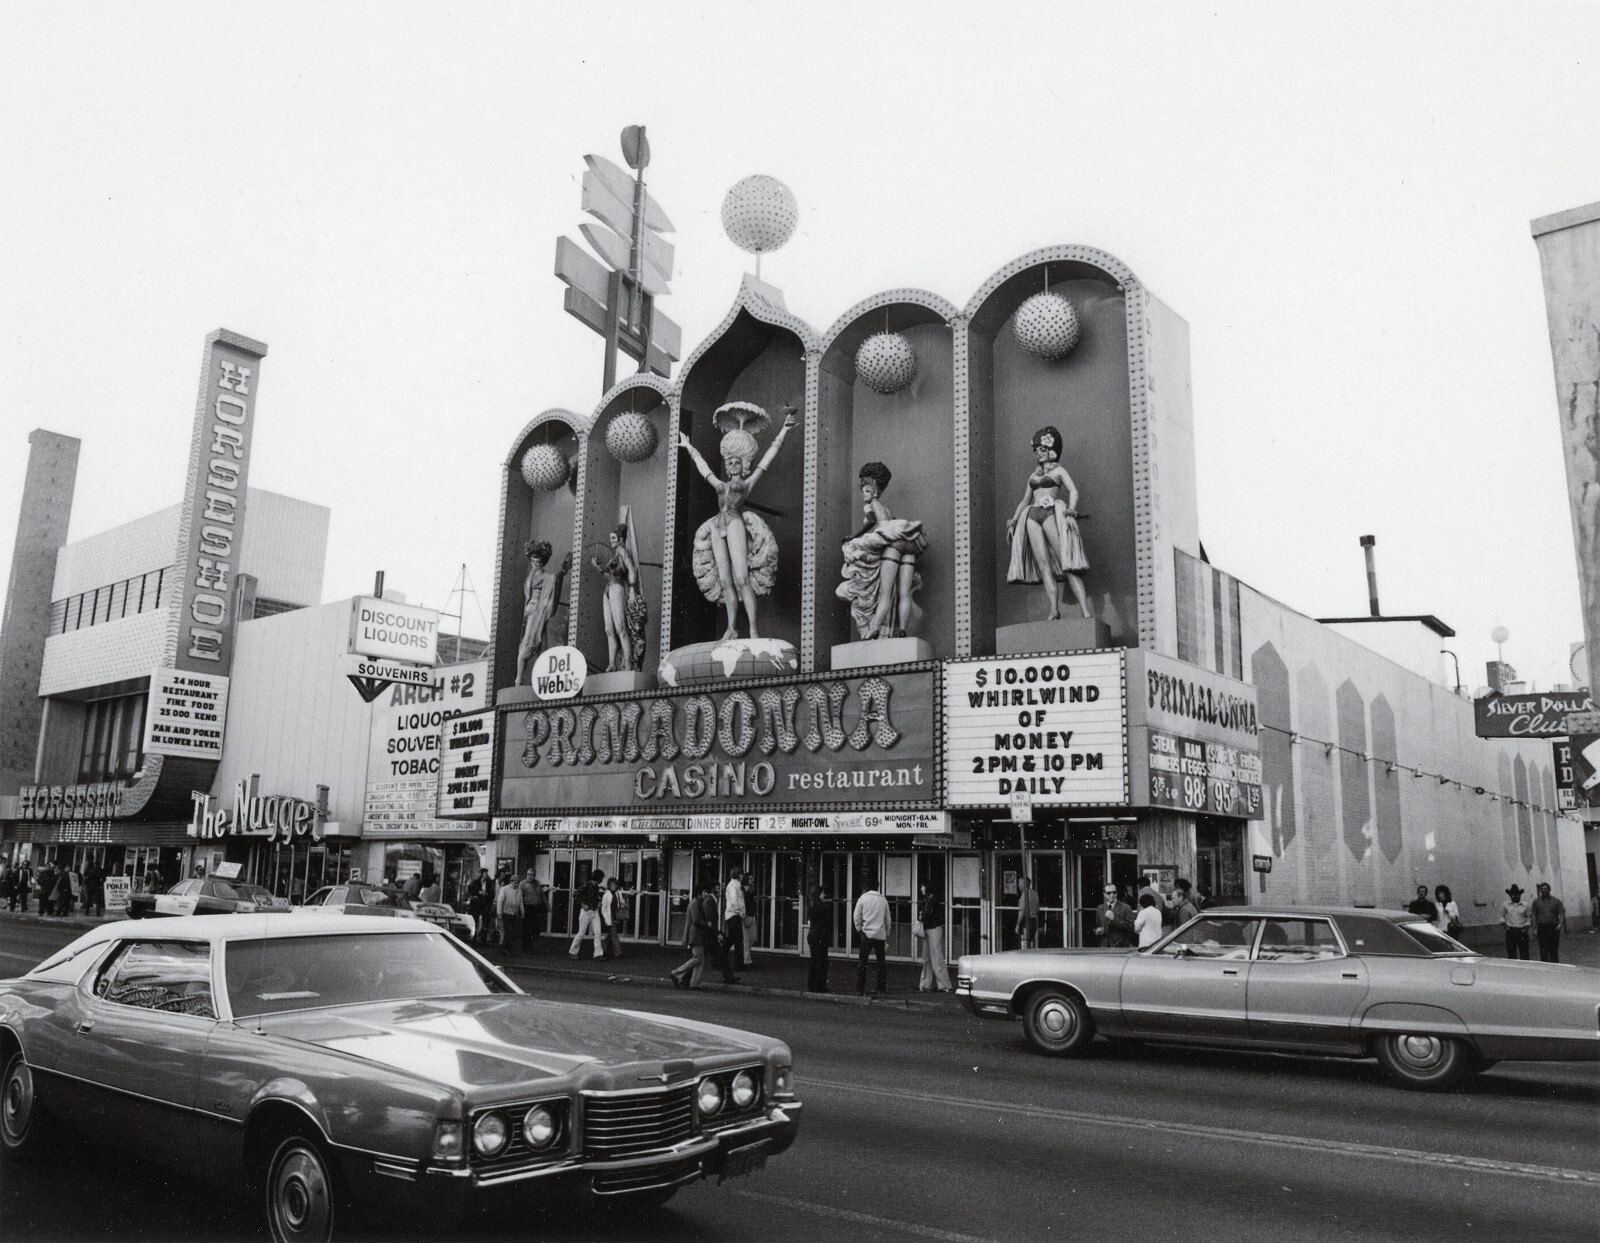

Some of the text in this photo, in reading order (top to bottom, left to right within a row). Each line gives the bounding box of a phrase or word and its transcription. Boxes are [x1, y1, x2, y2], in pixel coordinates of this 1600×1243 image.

[188, 360, 251, 661] HORSESHOE
[361, 609, 435, 633] DISCOUNT
[364, 627, 428, 649] LIQUORS
[358, 663, 428, 683] SOUVENIRS
[548, 653, 570, 674] Del
[173, 677, 211, 688] 24 HOUR
[450, 672, 475, 698] #2
[537, 672, 580, 694] Webb's
[162, 686, 218, 700] RESTAURANT
[968, 685, 1100, 708] WHIRLWIND
[166, 698, 214, 711] FINE FOOD
[194, 712, 217, 722] KENO
[522, 677, 900, 768] PRIMADONNA
[1018, 710, 1046, 727] OF
[151, 734, 219, 750] IN LOWER LEVEL
[172, 726, 191, 736] AND
[193, 728, 220, 739] POKER
[995, 731, 1074, 751] MONEY
[1152, 735, 1176, 755] STEAK
[1022, 755, 1036, 772] &
[1044, 754, 1065, 772] 10
[1071, 753, 1103, 771] PM
[634, 760, 776, 801] CASINO
[787, 762, 925, 790] restaurant
[999, 777, 1066, 795] DAILY
[187, 774, 329, 845] The Nugget
[533, 816, 563, 831] BUFFET
[631, 818, 685, 829] INTERNATIONAL
[686, 817, 721, 830] DINNER
[724, 816, 761, 830] BUFFET
[791, 817, 830, 828] NIGHT-OWL
